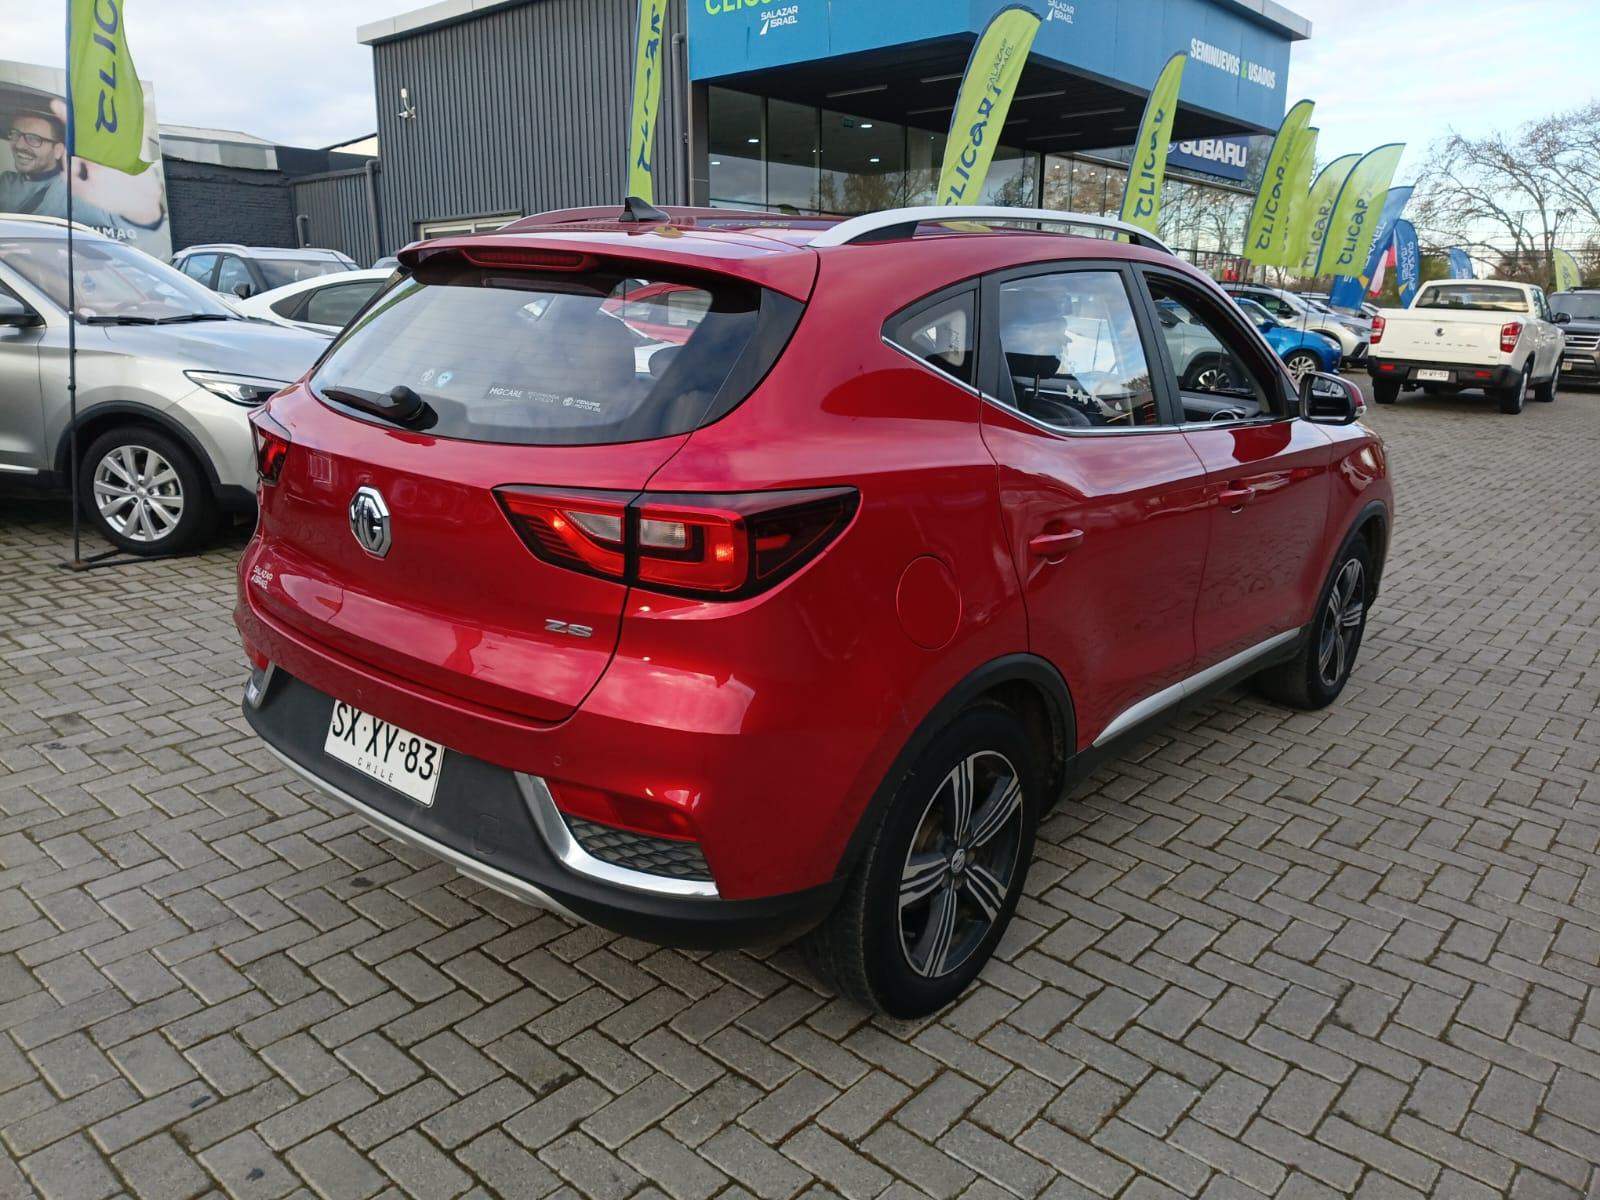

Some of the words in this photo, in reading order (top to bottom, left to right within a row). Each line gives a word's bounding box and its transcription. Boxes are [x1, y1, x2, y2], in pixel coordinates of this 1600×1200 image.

[761, 5, 799, 20] SALAZAR
[768, 15, 798, 28] ISRAEL
[1190, 37, 1241, 76] SEMINUEVOS
[1247, 61, 1276, 89] USADOS
[1179, 138, 1248, 168] SUBARU
[544, 618, 593, 638] ZS
